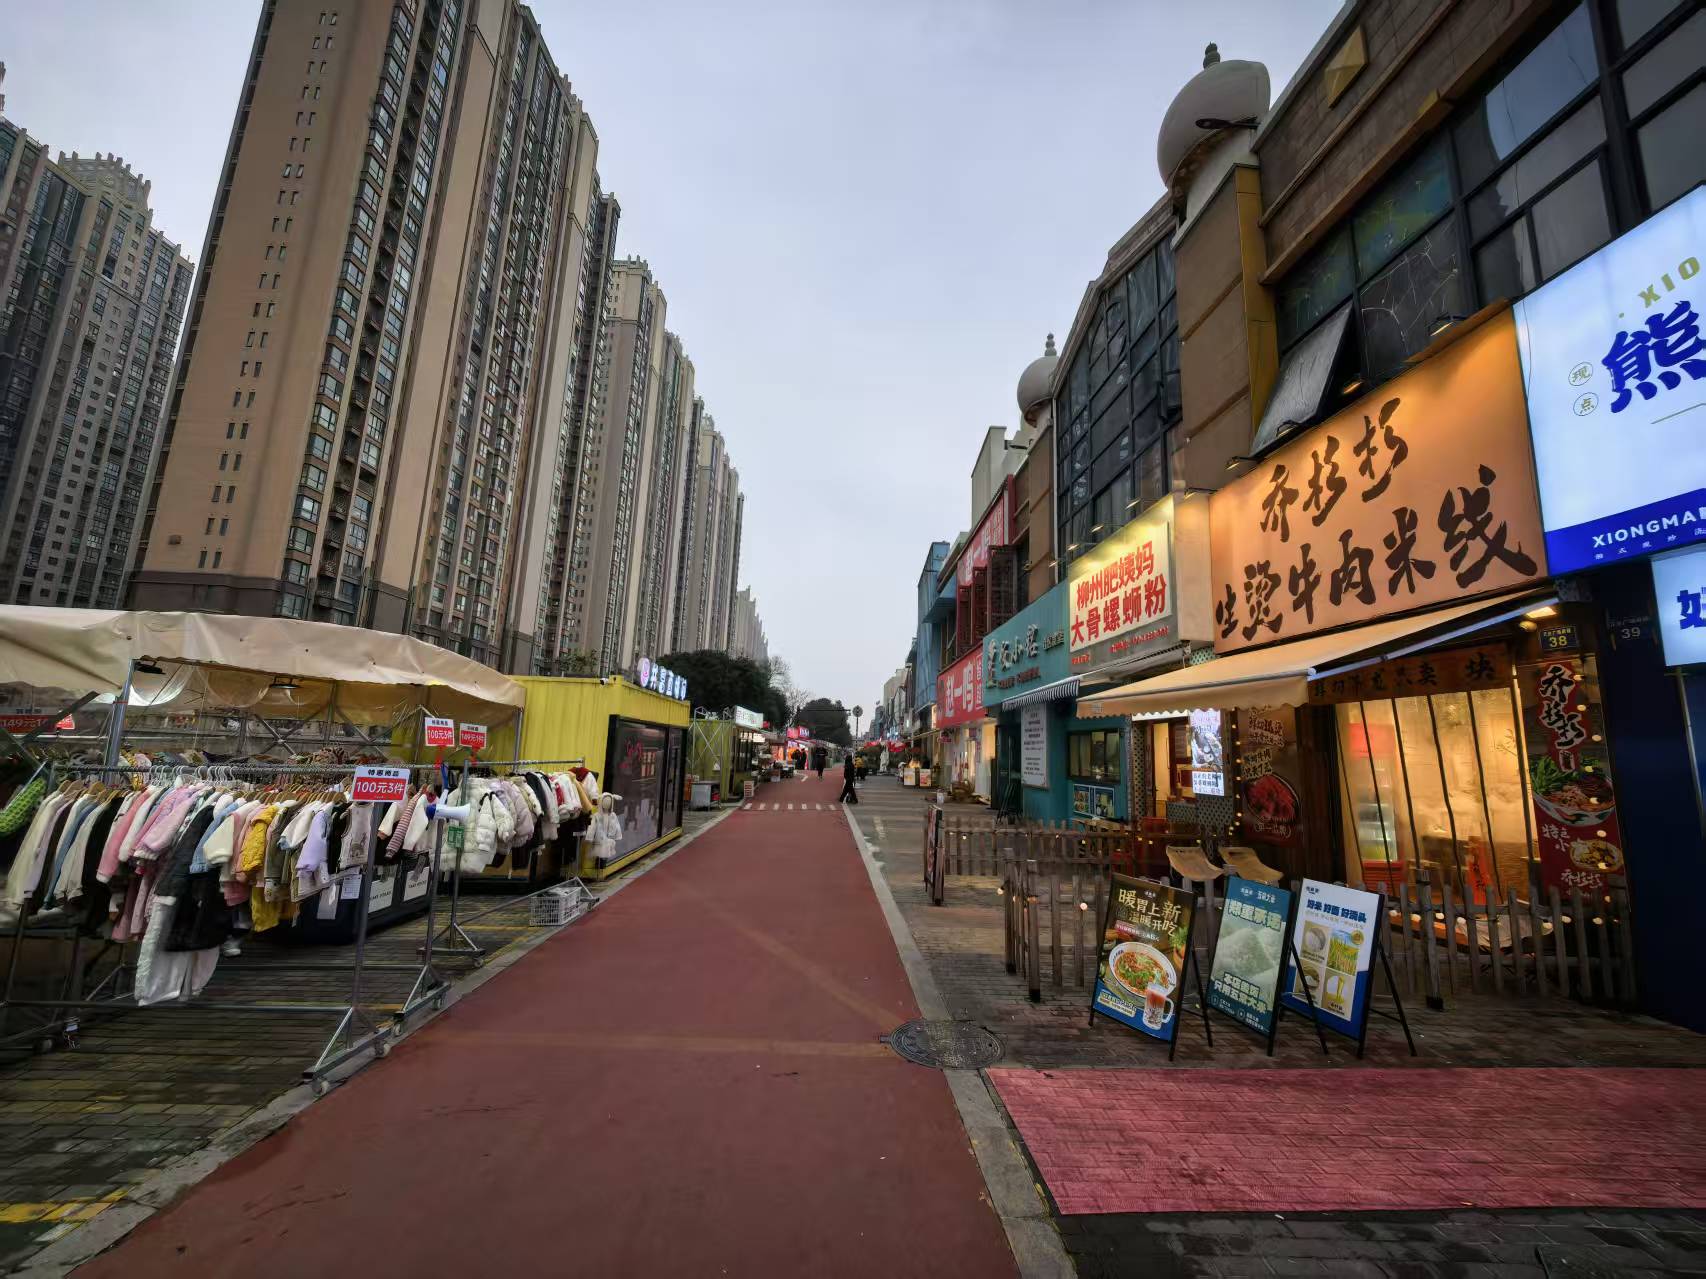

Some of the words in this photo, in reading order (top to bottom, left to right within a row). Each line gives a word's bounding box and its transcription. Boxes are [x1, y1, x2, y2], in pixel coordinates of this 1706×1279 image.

[1261, 397, 1408, 542] 乔杉杉
[1215, 464, 1537, 638] 生烫牛肉米线
[1077, 541, 1154, 611] 柳州肥姨妈
[1071, 574, 1167, 647] 大骨螺蛳粉
[1549, 635, 1567, 648] 38
[1622, 627, 1641, 639] 39
[356, 781, 404, 794] 100元3件
[368, 769, 399, 777] 特惠商品
[1119, 888, 1181, 923] 暖胃上新
